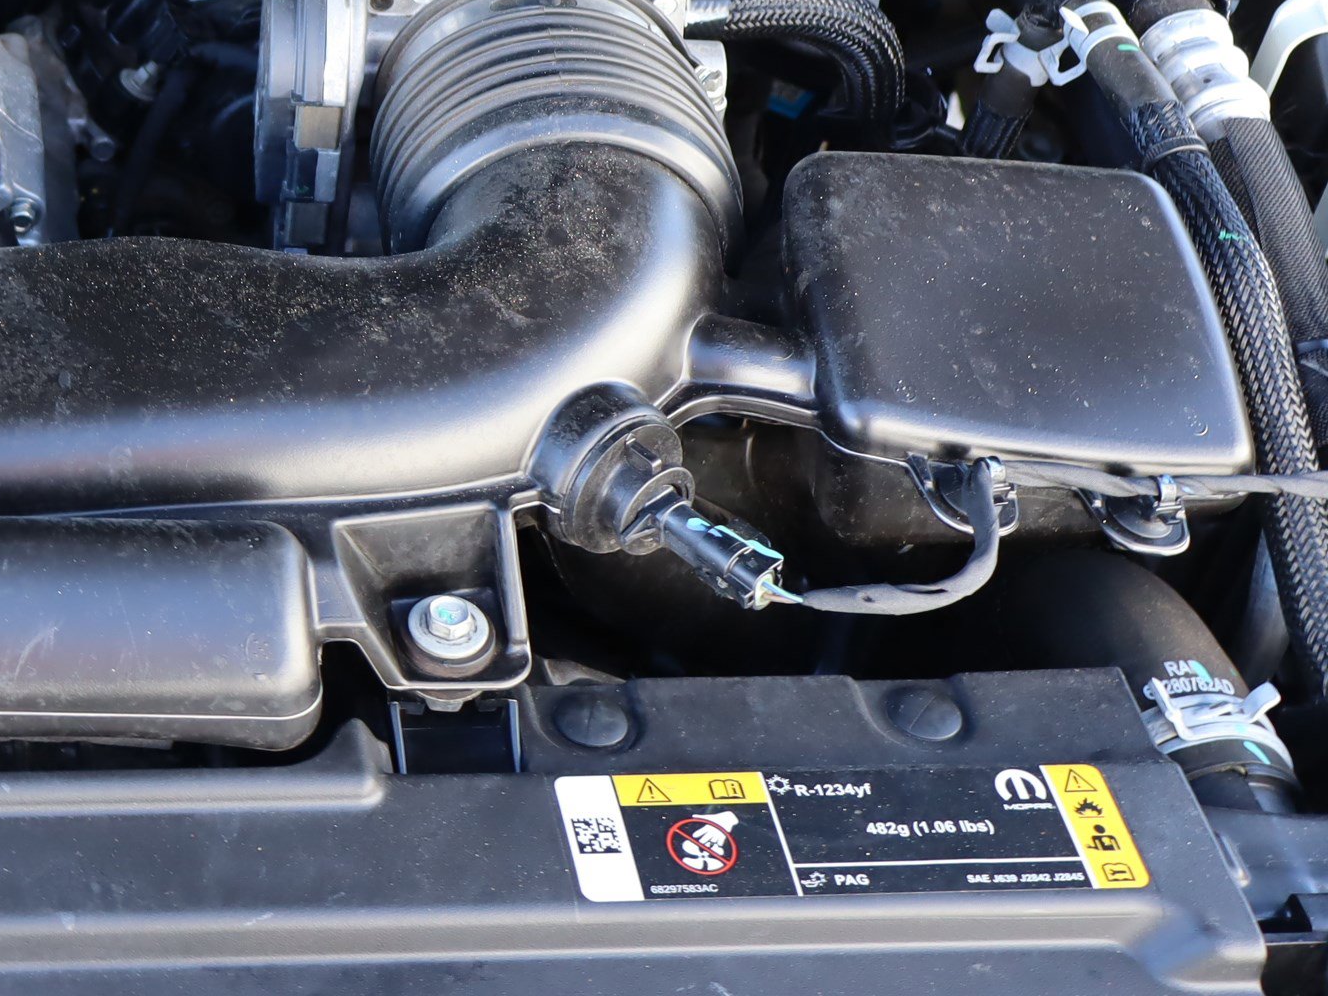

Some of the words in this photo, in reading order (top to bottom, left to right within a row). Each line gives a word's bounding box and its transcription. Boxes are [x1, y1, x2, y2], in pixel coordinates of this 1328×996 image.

[1142, 676, 1235, 700] 6280782AD
[794, 783, 871, 798] R-1234yf
[866, 821, 910, 837] 482g
[913, 820, 957, 837] (1.06
[958, 819, 995, 835] lbs)
[833, 873, 870, 886] PAG
[966, 874, 991, 883] SAE
[993, 873, 1018, 883] J639
[650, 884, 719, 894] 68297583AC
